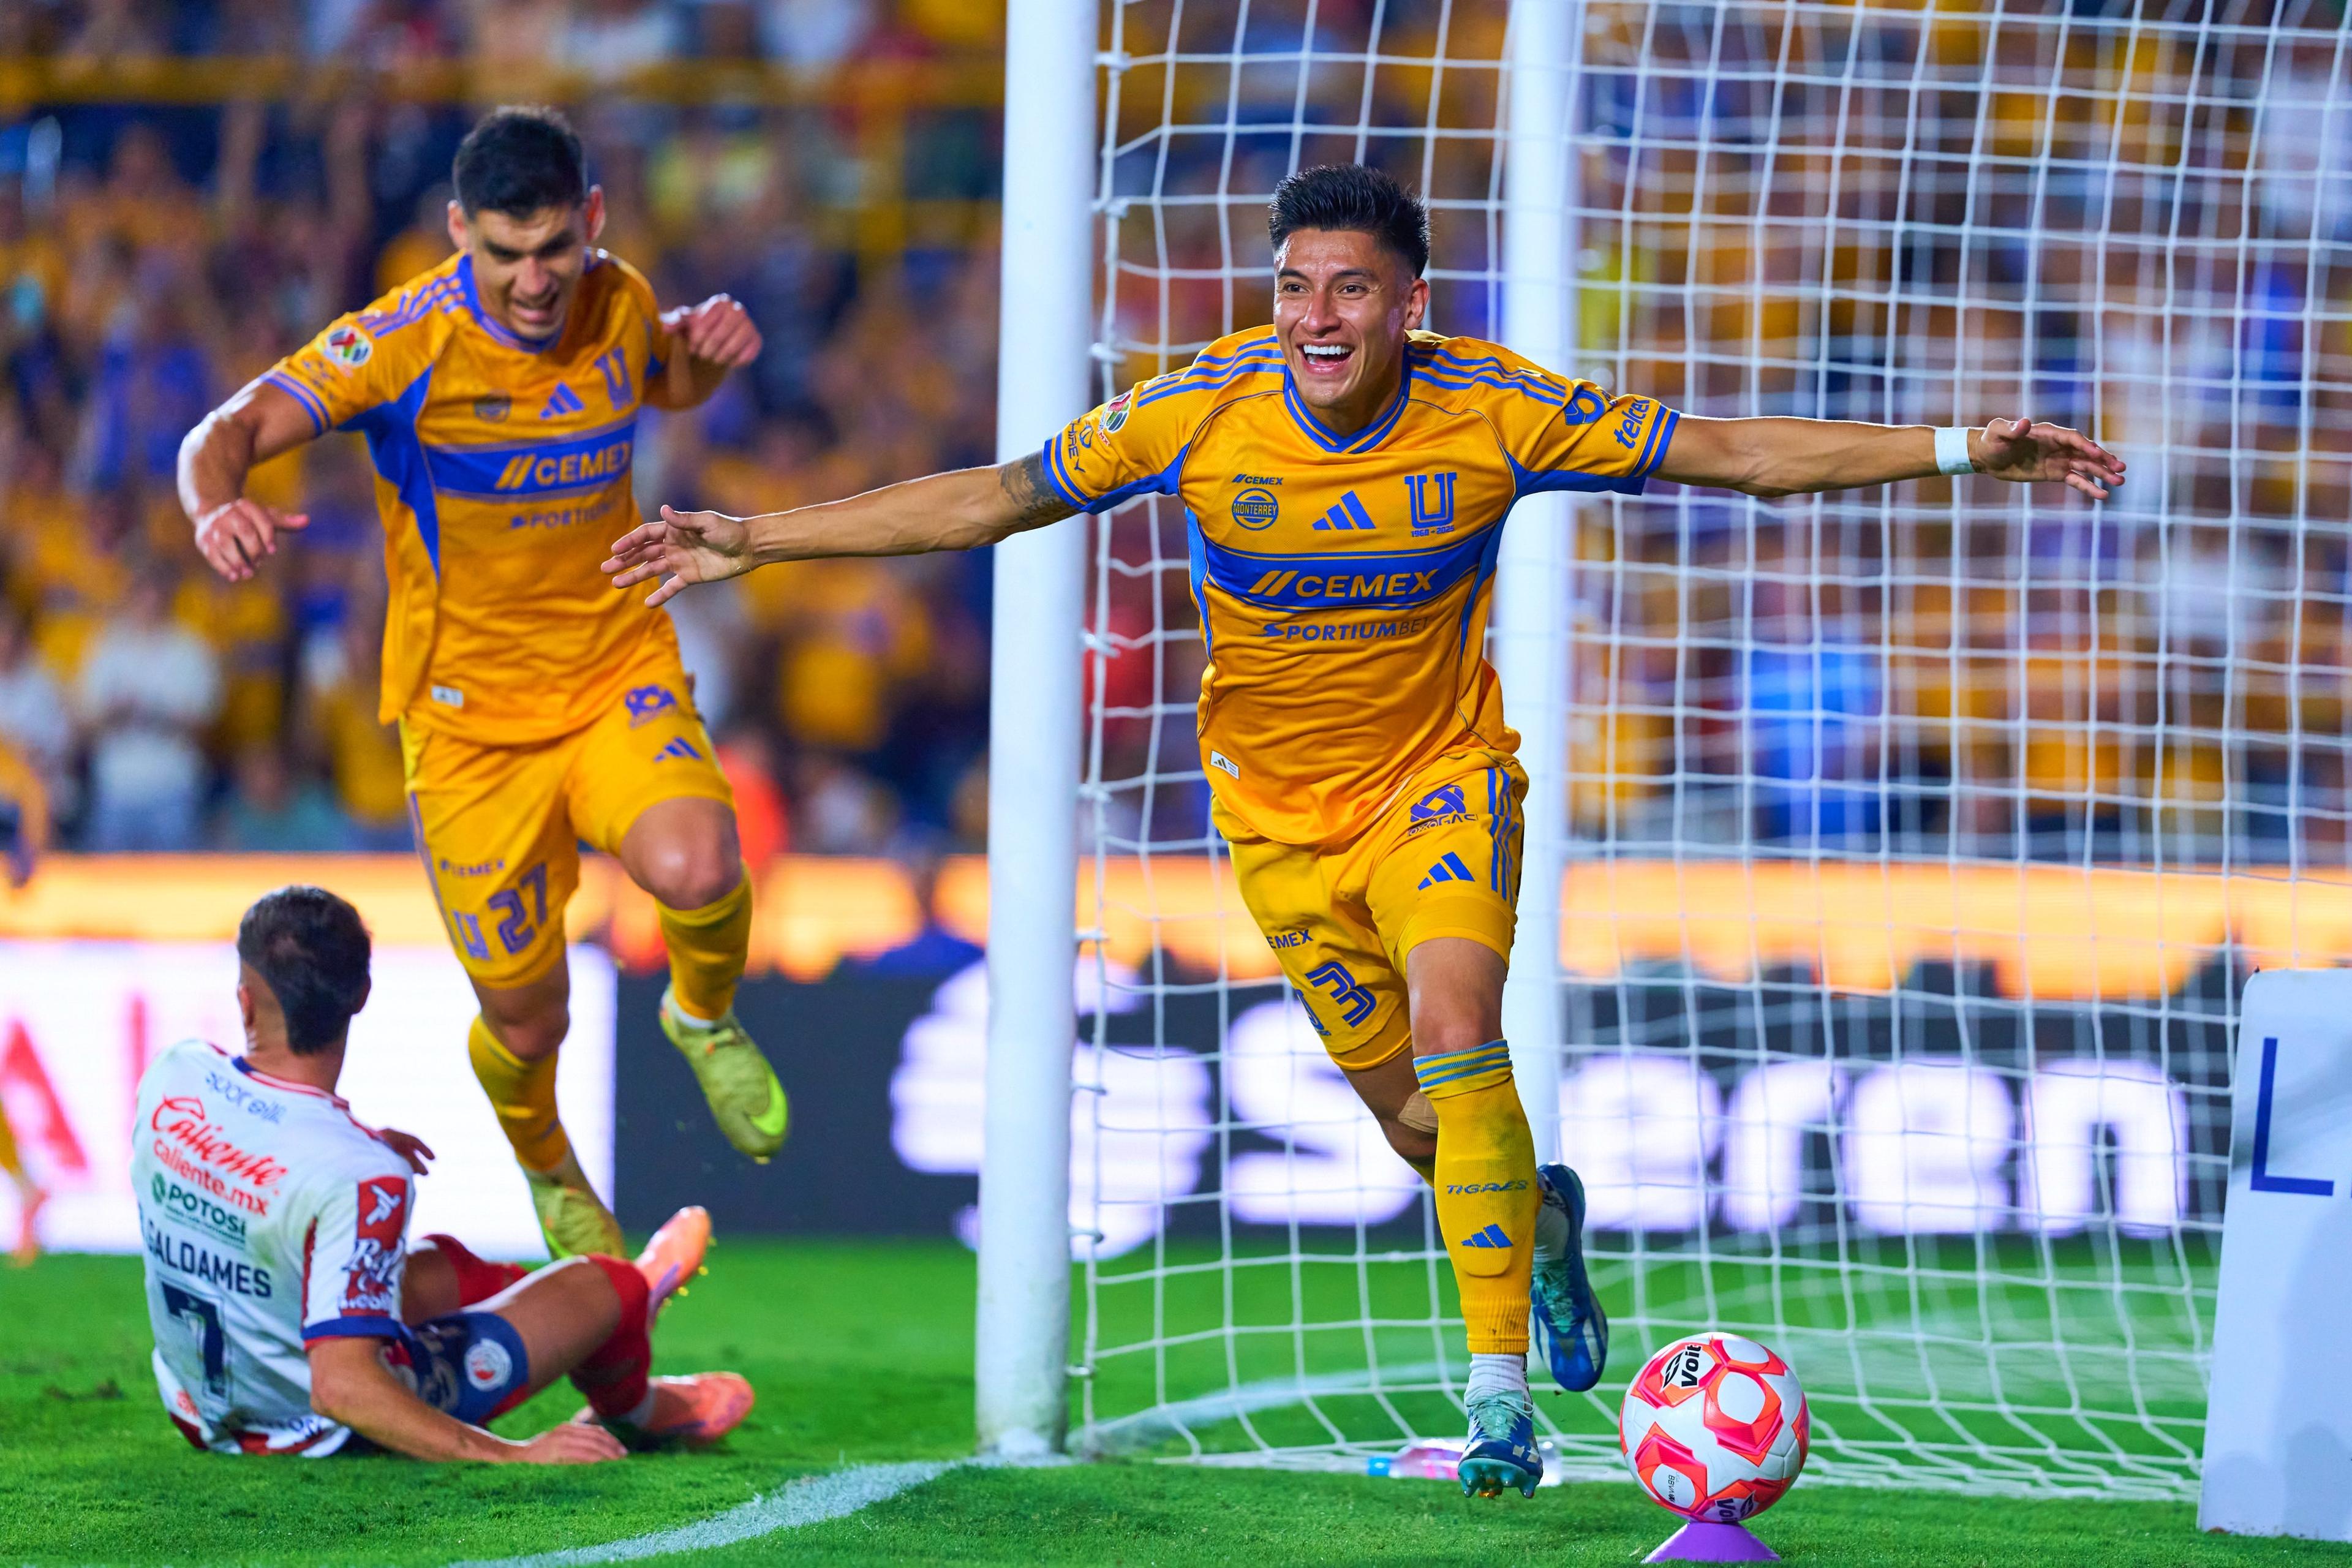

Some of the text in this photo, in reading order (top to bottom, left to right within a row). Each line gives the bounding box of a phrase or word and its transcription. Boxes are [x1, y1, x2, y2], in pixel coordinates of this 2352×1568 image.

[1068, 418, 1085, 473] HIREY
[1614, 400, 1650, 449] telcel
[1245, 476, 1284, 485] CEMEX
[1404, 472, 1457, 529] U
[1233, 503, 1277, 516] MONTERREY
[1295, 568, 1439, 598] CEMEX
[488, 861, 547, 956] 27
[1266, 929, 1314, 949] EMEX
[1305, 961, 1377, 1028] 3
[151, 1095, 288, 1187] Caliente
[1227, 1001, 2190, 1238] Seren
[2250, 1038, 2352, 1197] L
[154, 1139, 269, 1216] caliente.mx
[1447, 1180, 1528, 1194] TIGRES
[160, 1280, 227, 1400] 7
[1681, 1345, 1702, 1387] Voit
[1716, 1498, 1738, 1521] Voi
